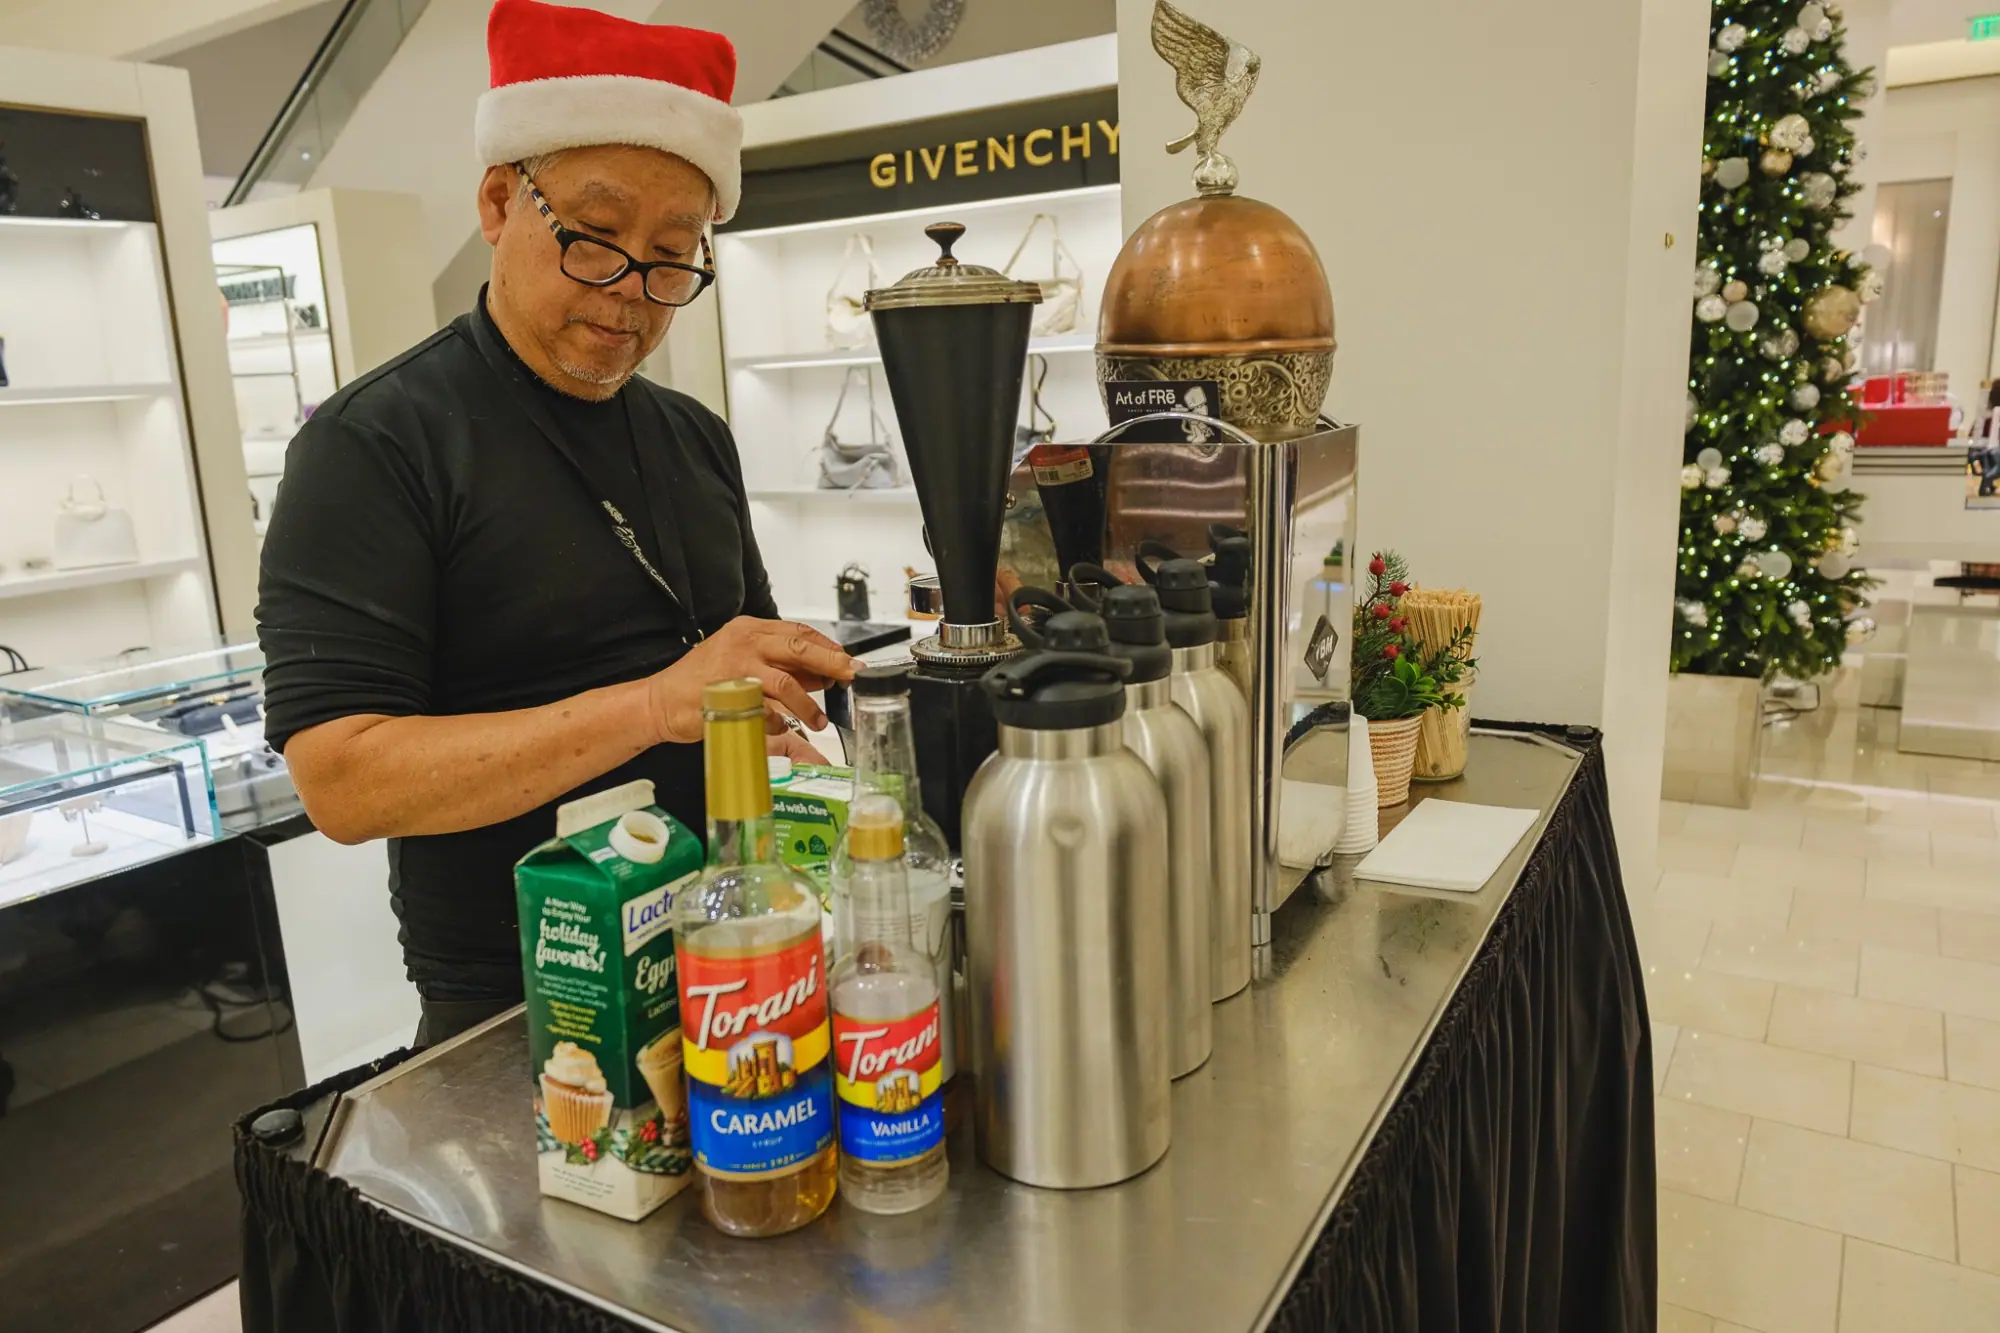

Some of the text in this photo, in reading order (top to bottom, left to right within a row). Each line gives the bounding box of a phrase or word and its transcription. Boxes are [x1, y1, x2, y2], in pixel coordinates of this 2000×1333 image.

[870, 120, 1119, 188] GIVENCHY
[1115, 391, 1133, 405] Art
[1135, 391, 1146, 405] of
[786, 803, 808, 814] with
[536, 938, 607, 973] favorites!
[540, 918, 600, 956] holiday
[687, 955, 818, 1052] Torani
[839, 1006, 938, 1085] Torani
[711, 1097, 817, 1135] CARAMEL
[870, 1114, 929, 1137] VANILLA
